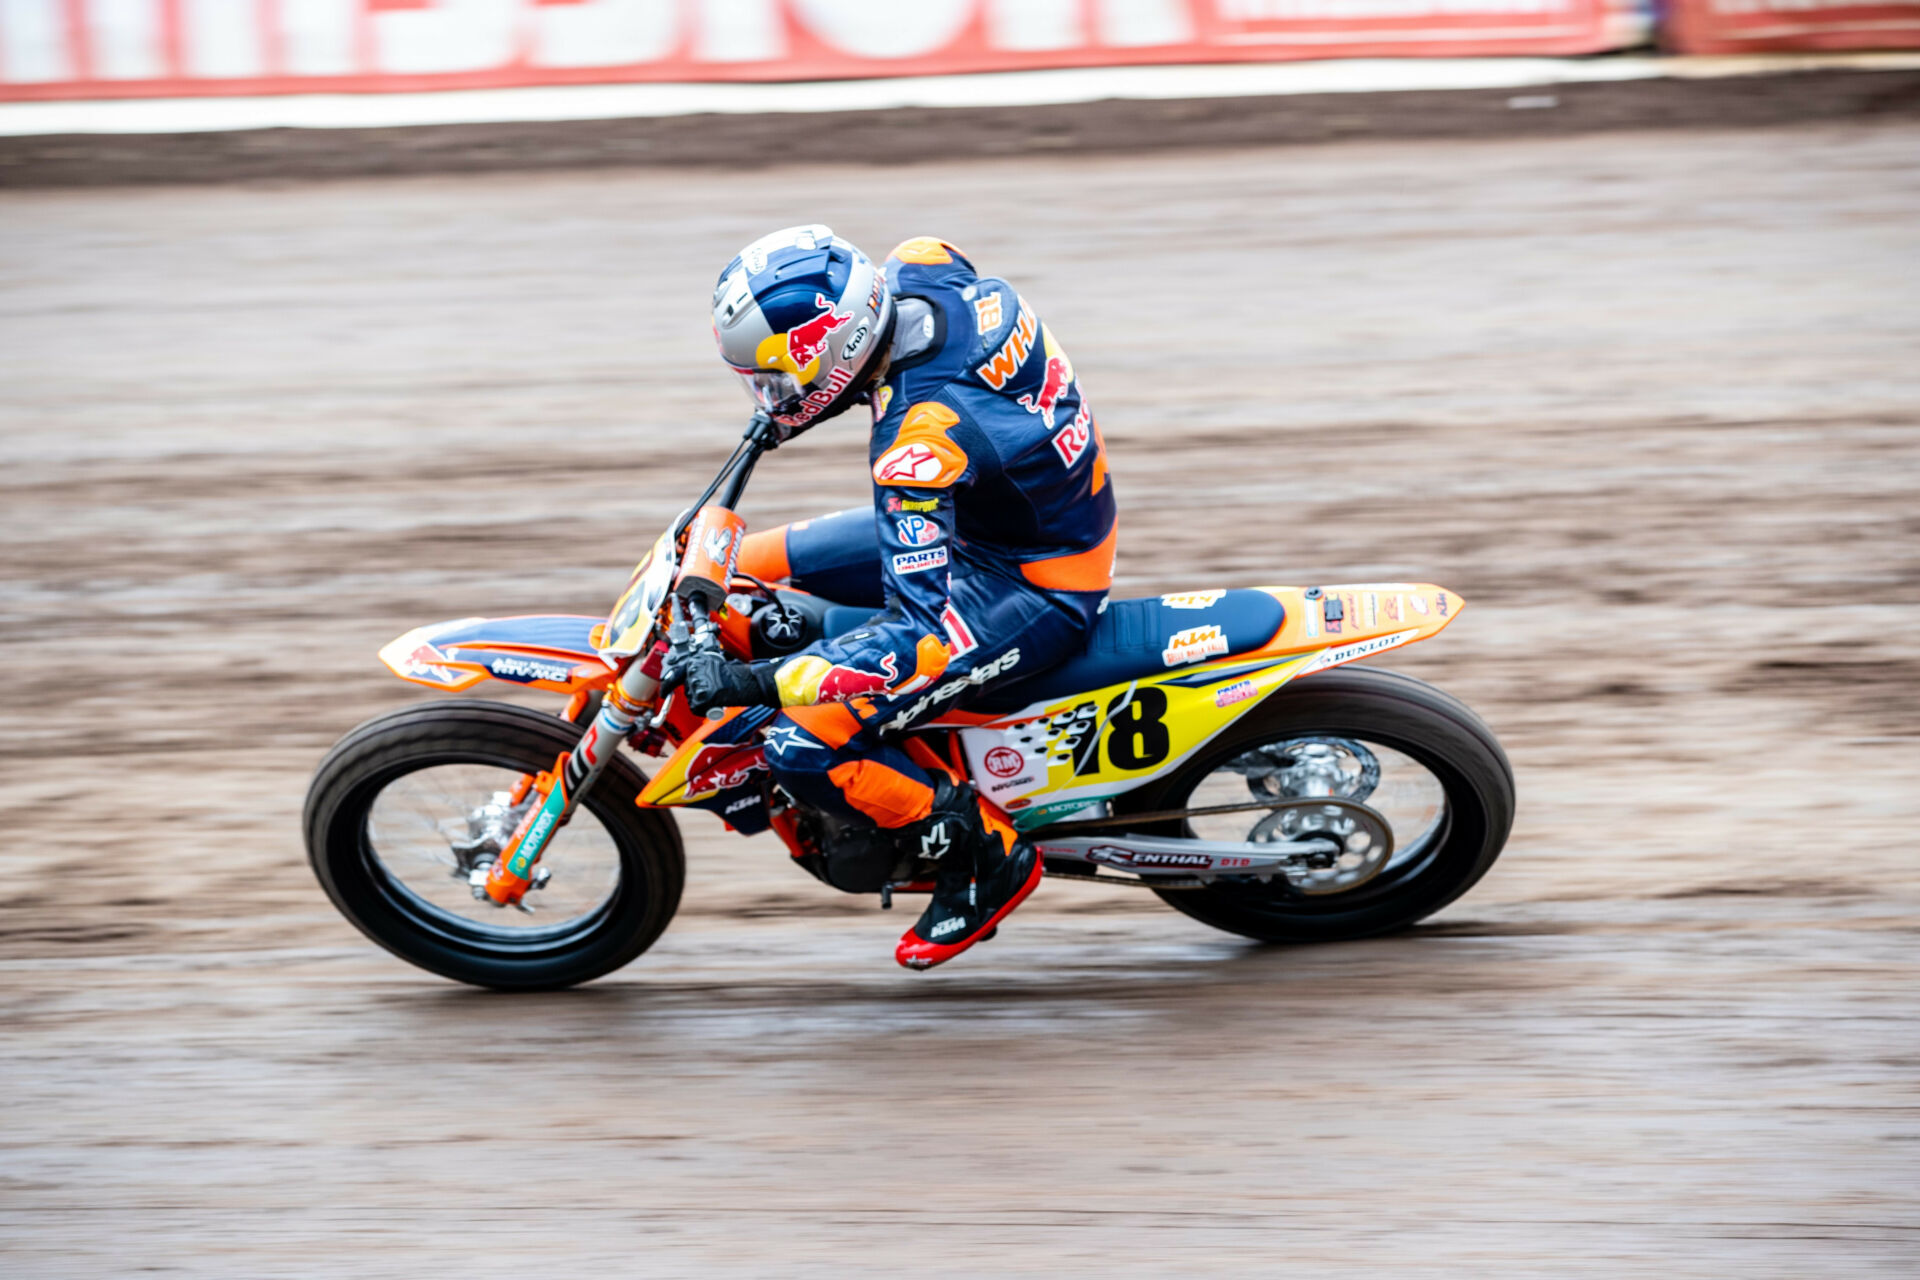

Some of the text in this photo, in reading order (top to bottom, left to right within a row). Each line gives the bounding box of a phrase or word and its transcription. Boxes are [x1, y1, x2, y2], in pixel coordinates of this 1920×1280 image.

[900, 516, 925, 545] VP
[896, 549, 945, 567] PARTS
[1173, 629, 1216, 650] KTM
[1051, 687, 1169, 776] 18
[725, 795, 761, 815] KTM
[930, 916, 966, 938] KTM
